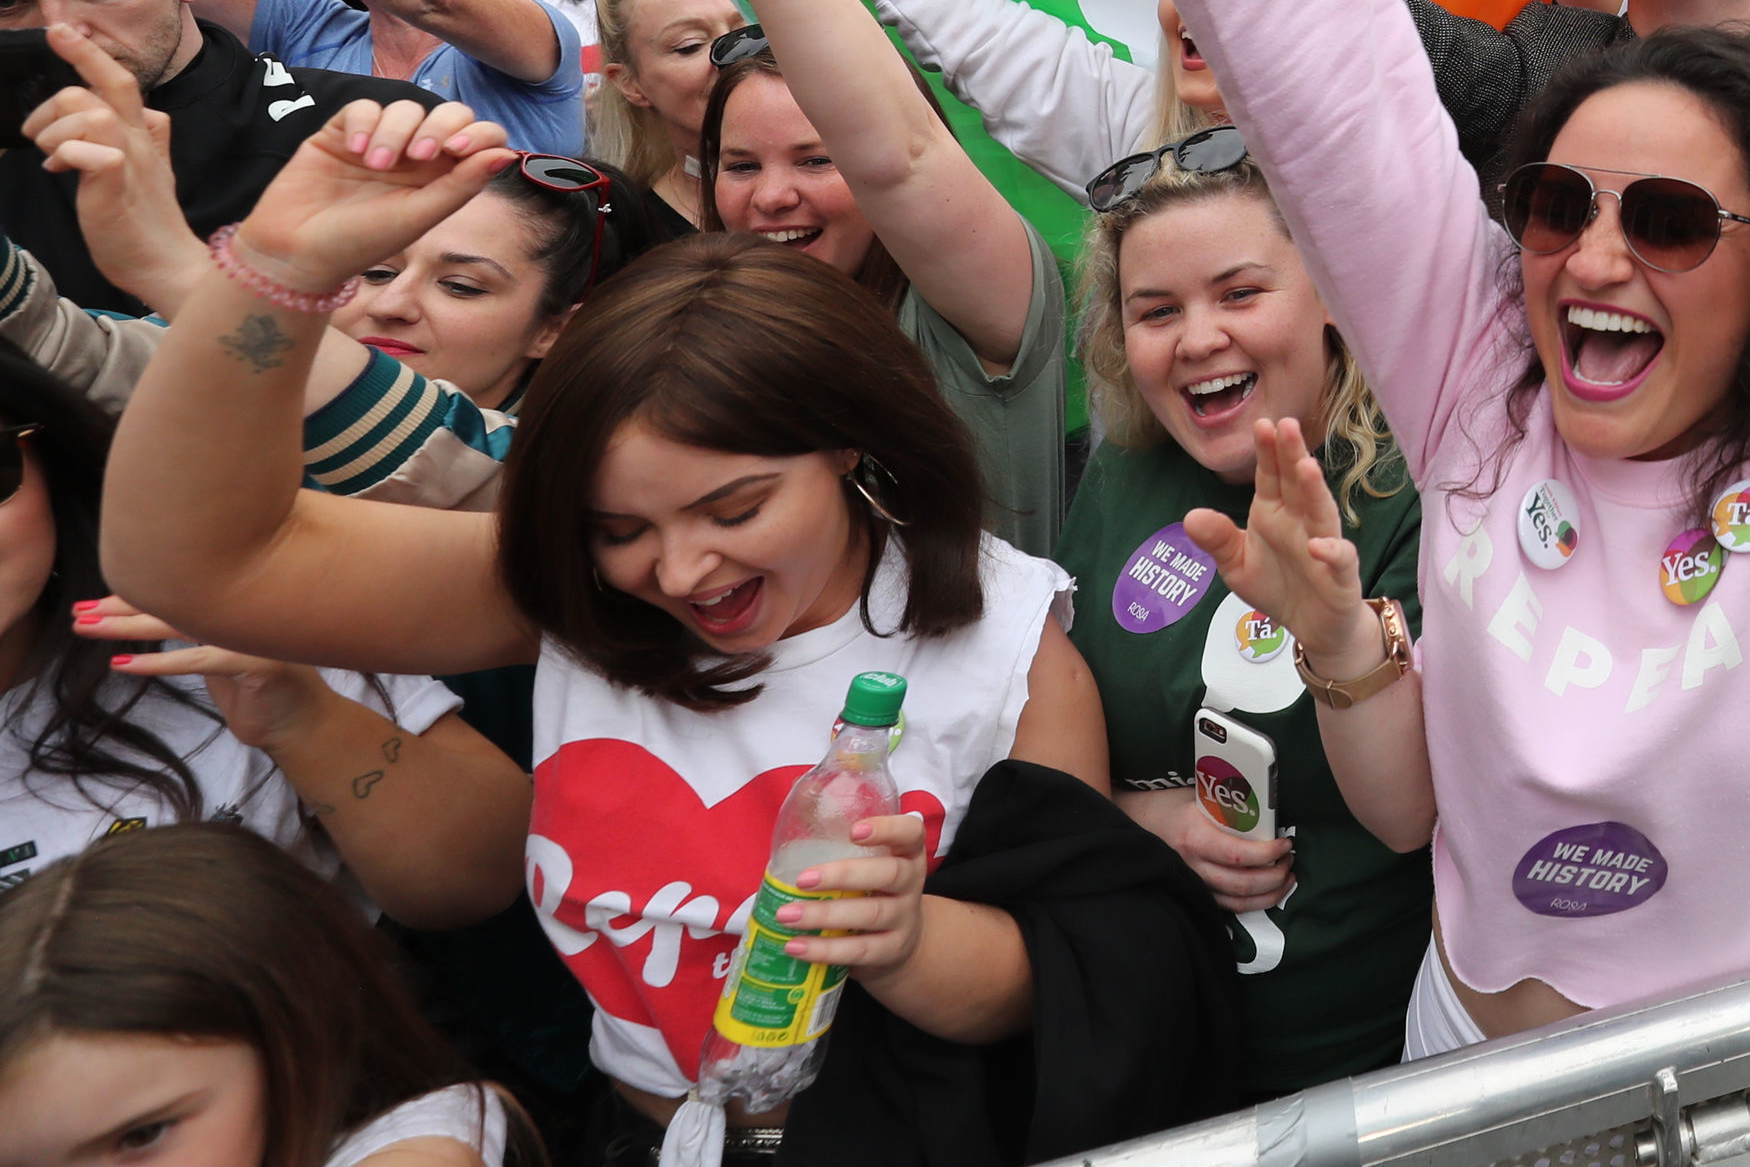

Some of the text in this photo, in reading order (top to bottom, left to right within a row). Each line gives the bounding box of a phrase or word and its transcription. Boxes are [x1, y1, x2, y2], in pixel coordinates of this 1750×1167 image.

[1525, 491, 1552, 549] Yes.
[1151, 540, 1208, 582] WE MADE
[1662, 551, 1717, 586] Yes.
[1128, 556, 1198, 607] HISTORY
[1127, 601, 1151, 622] ROSA
[1245, 616, 1278, 641] Tá.
[1196, 770, 1256, 817] Yes.
[1553, 842, 1653, 873] WE MADE
[1527, 859, 1650, 896] HISTORY
[1550, 897, 1588, 911] ROSA
